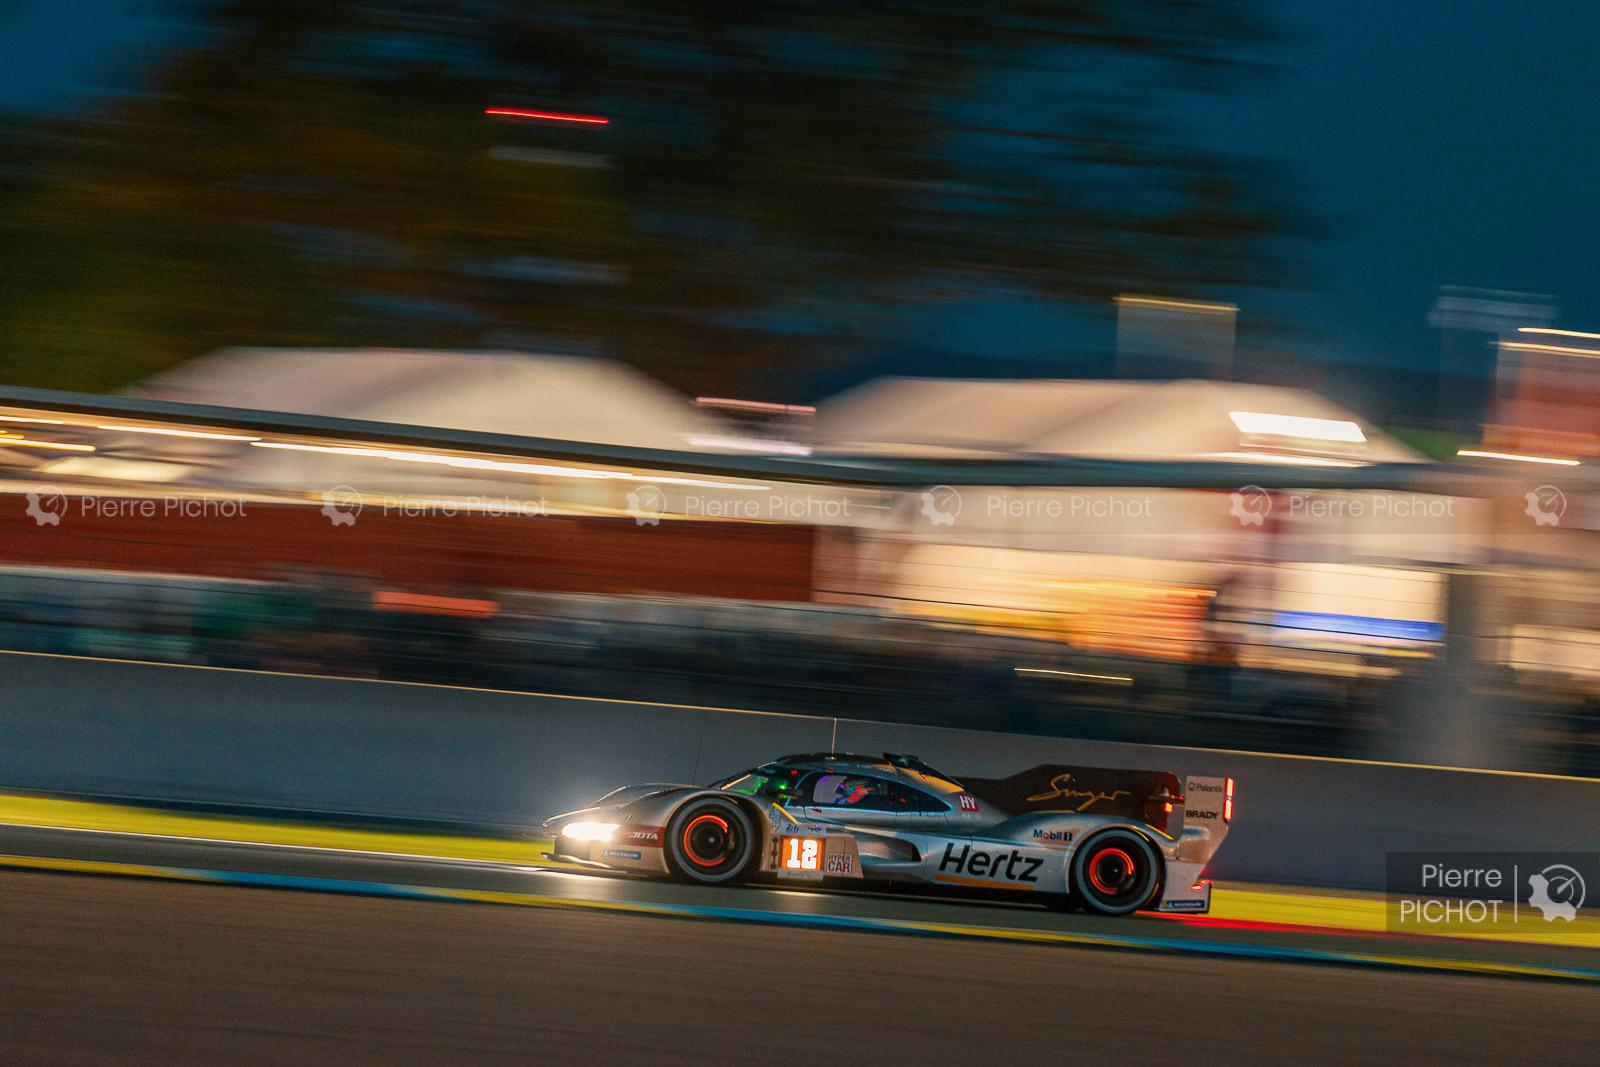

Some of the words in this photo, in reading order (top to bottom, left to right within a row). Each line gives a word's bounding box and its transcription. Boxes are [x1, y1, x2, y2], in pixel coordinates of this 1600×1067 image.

[1026, 773, 1131, 812] Singer
[1186, 809, 1218, 820] BRADY
[1033, 829, 1063, 841] Mobil
[828, 861, 851, 873] CAR
[938, 842, 1044, 882] Hertz
